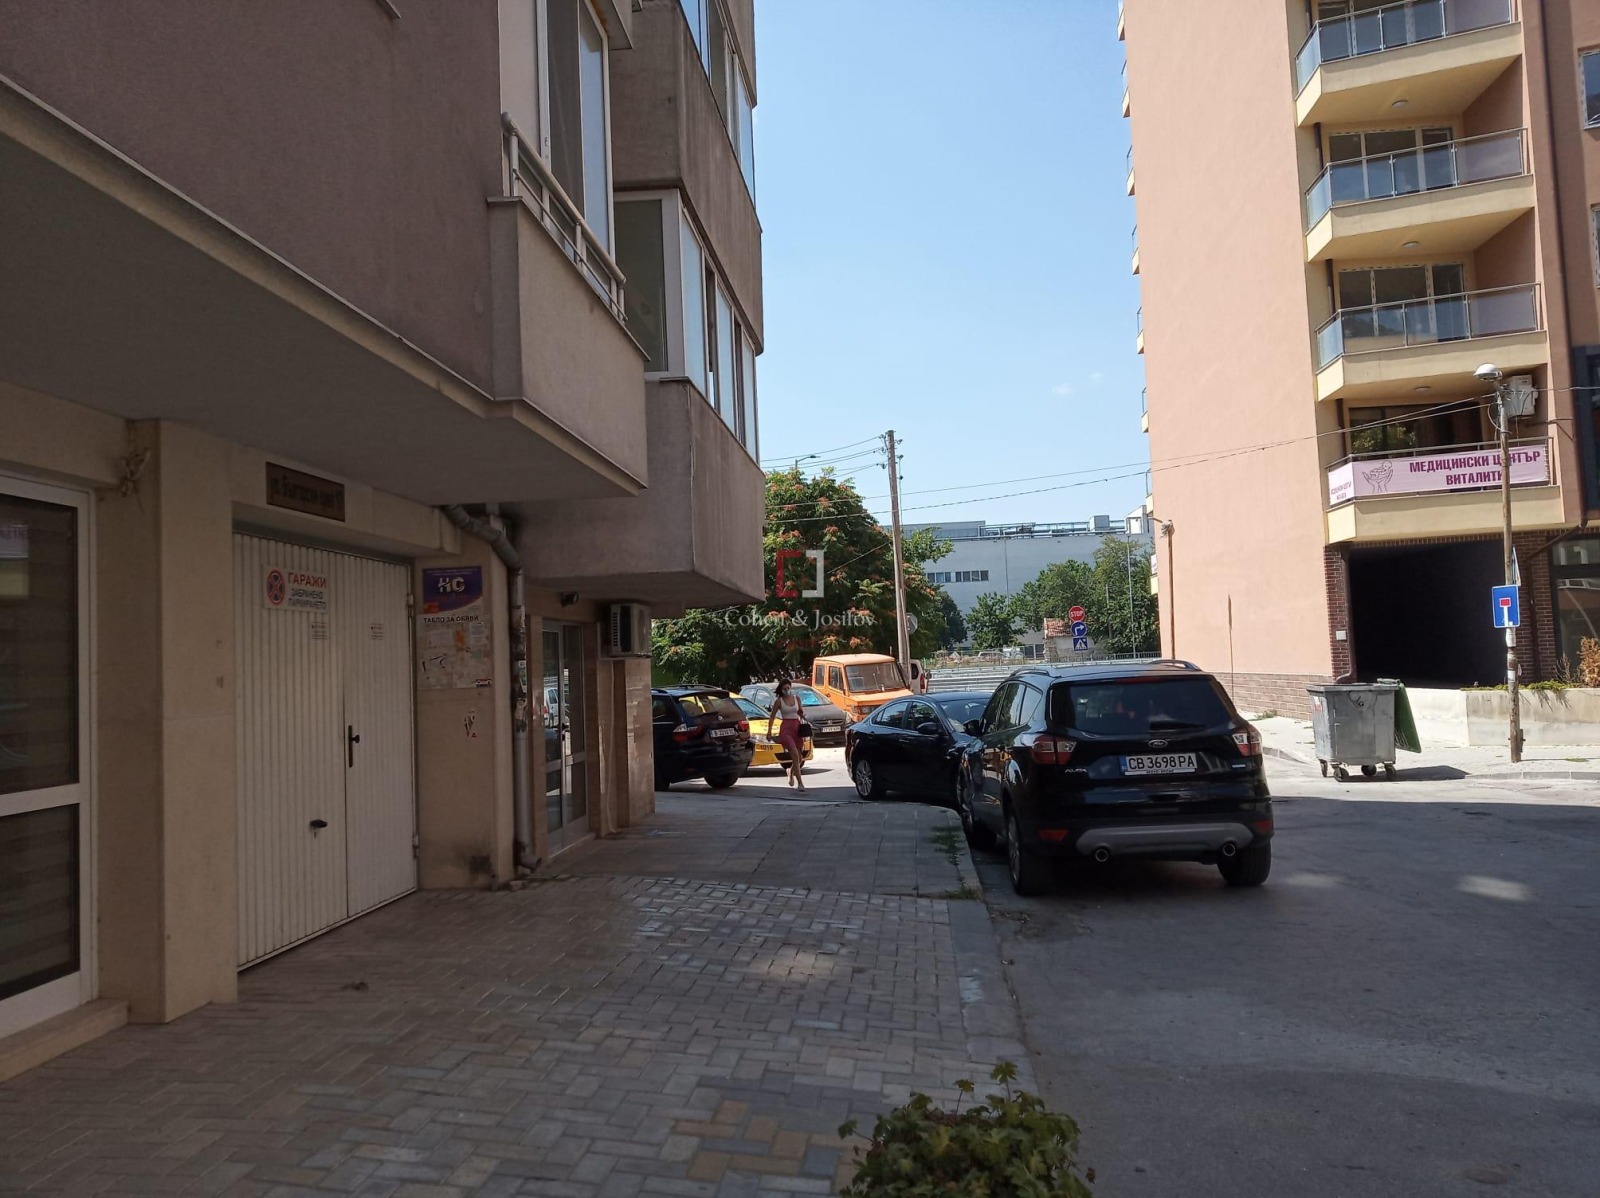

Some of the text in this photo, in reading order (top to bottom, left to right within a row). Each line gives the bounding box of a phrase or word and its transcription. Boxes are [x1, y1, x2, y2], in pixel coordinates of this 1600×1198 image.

[1409, 451, 1540, 473] МЕДИЦИНСКИ ЦНТЪР
[288, 572, 327, 588] ГАРАЖИ
[1147, 756, 1177, 769] 3698
